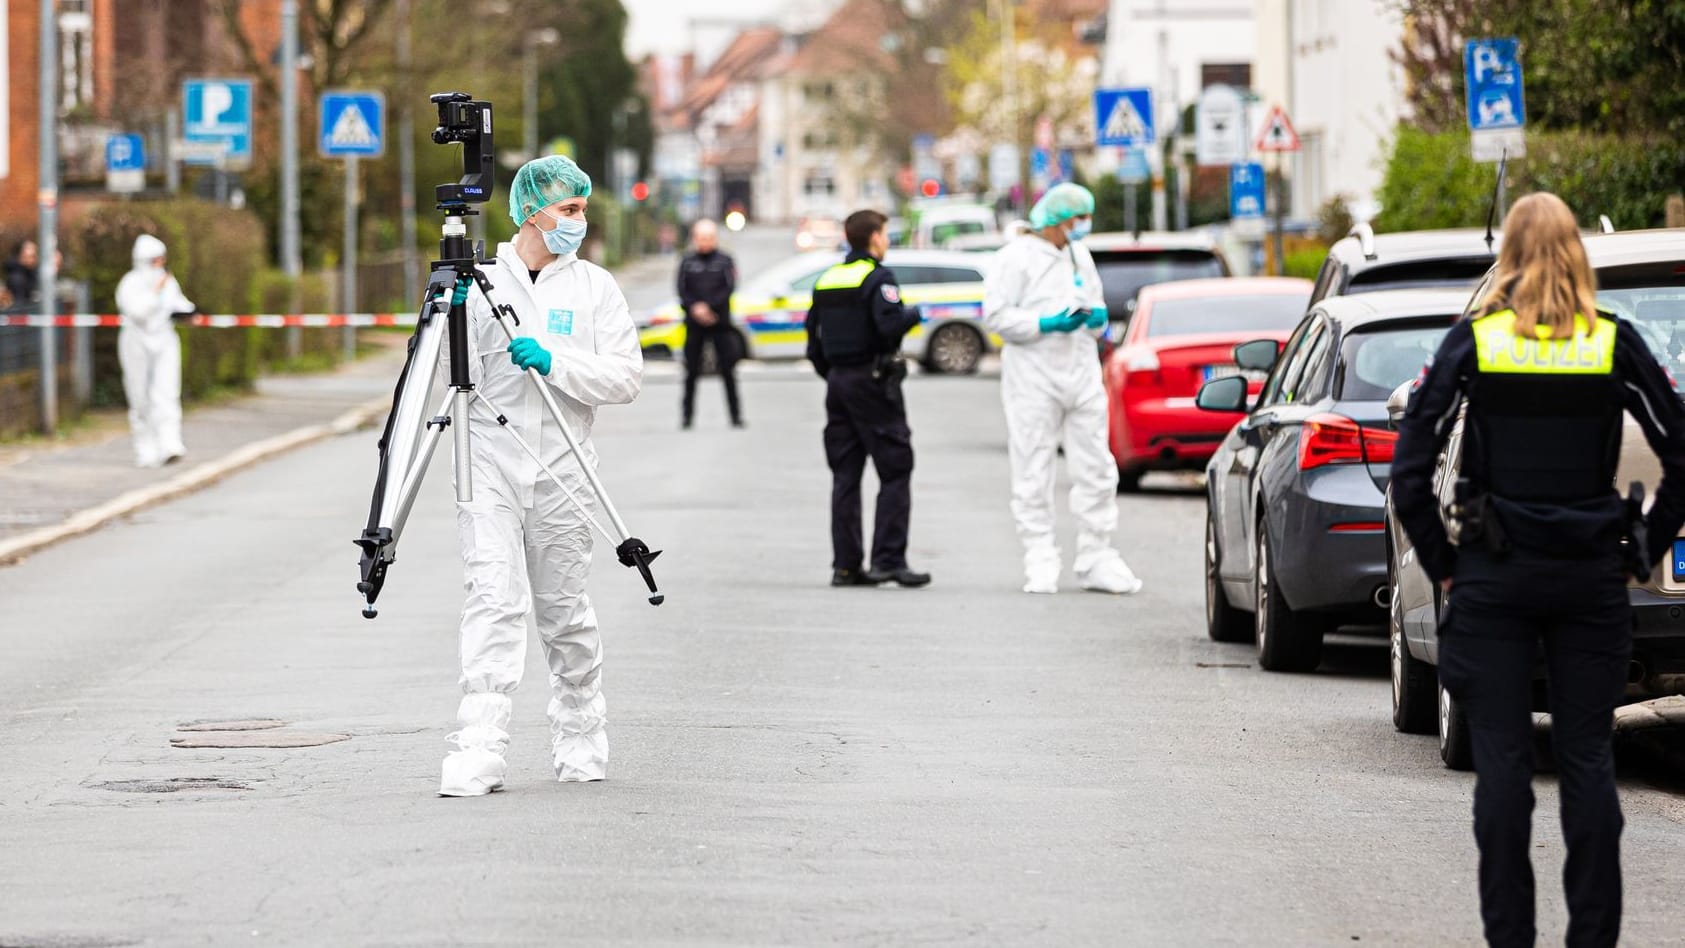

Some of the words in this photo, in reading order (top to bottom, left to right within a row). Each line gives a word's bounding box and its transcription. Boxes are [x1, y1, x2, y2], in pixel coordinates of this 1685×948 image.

[1474, 46, 1500, 82] P
[202, 84, 232, 127] P
[1488, 331, 1603, 367] POLIZEI
